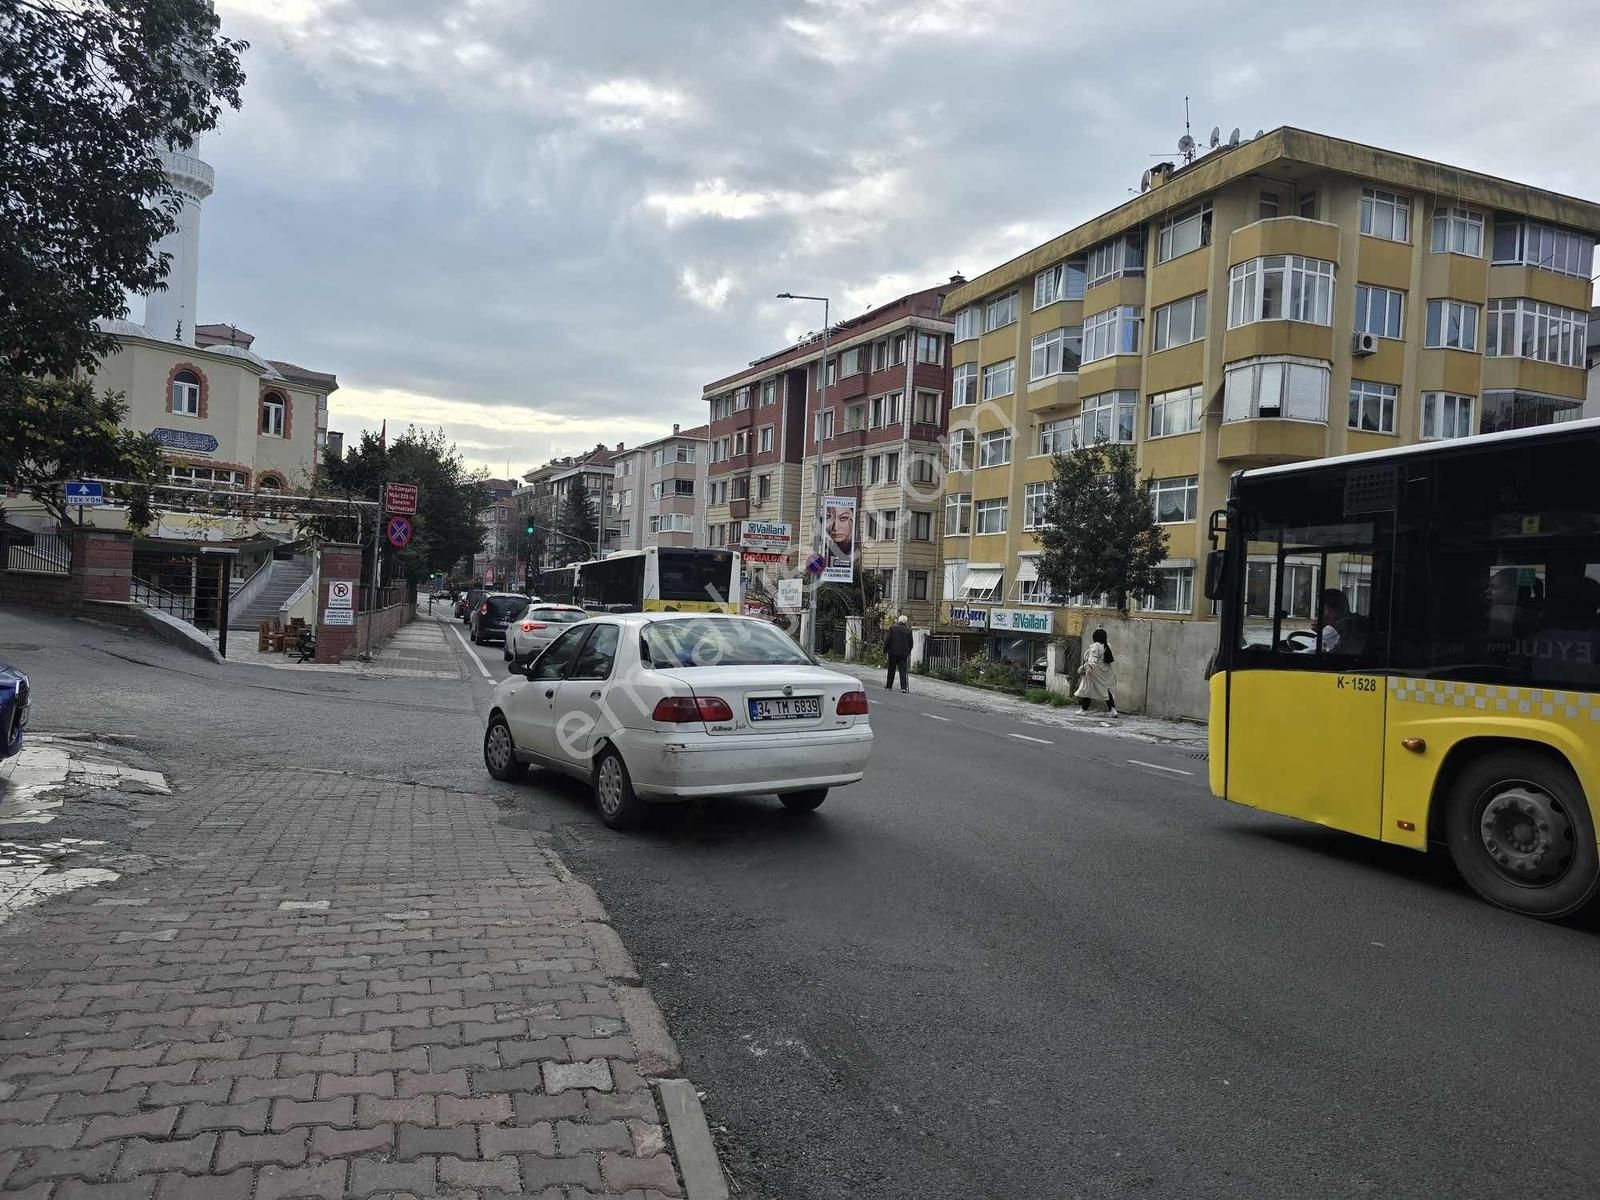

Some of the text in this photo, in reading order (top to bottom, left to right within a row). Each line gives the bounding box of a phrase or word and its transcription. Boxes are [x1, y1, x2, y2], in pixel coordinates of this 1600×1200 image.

[756, 524, 786, 535] Vaillant
[1020, 612, 1049, 630] Vaillant
[1337, 676, 1376, 691] K-1528
[758, 702, 771, 715] 34
[776, 701, 790, 713] TM
[794, 699, 818, 713] 6839
